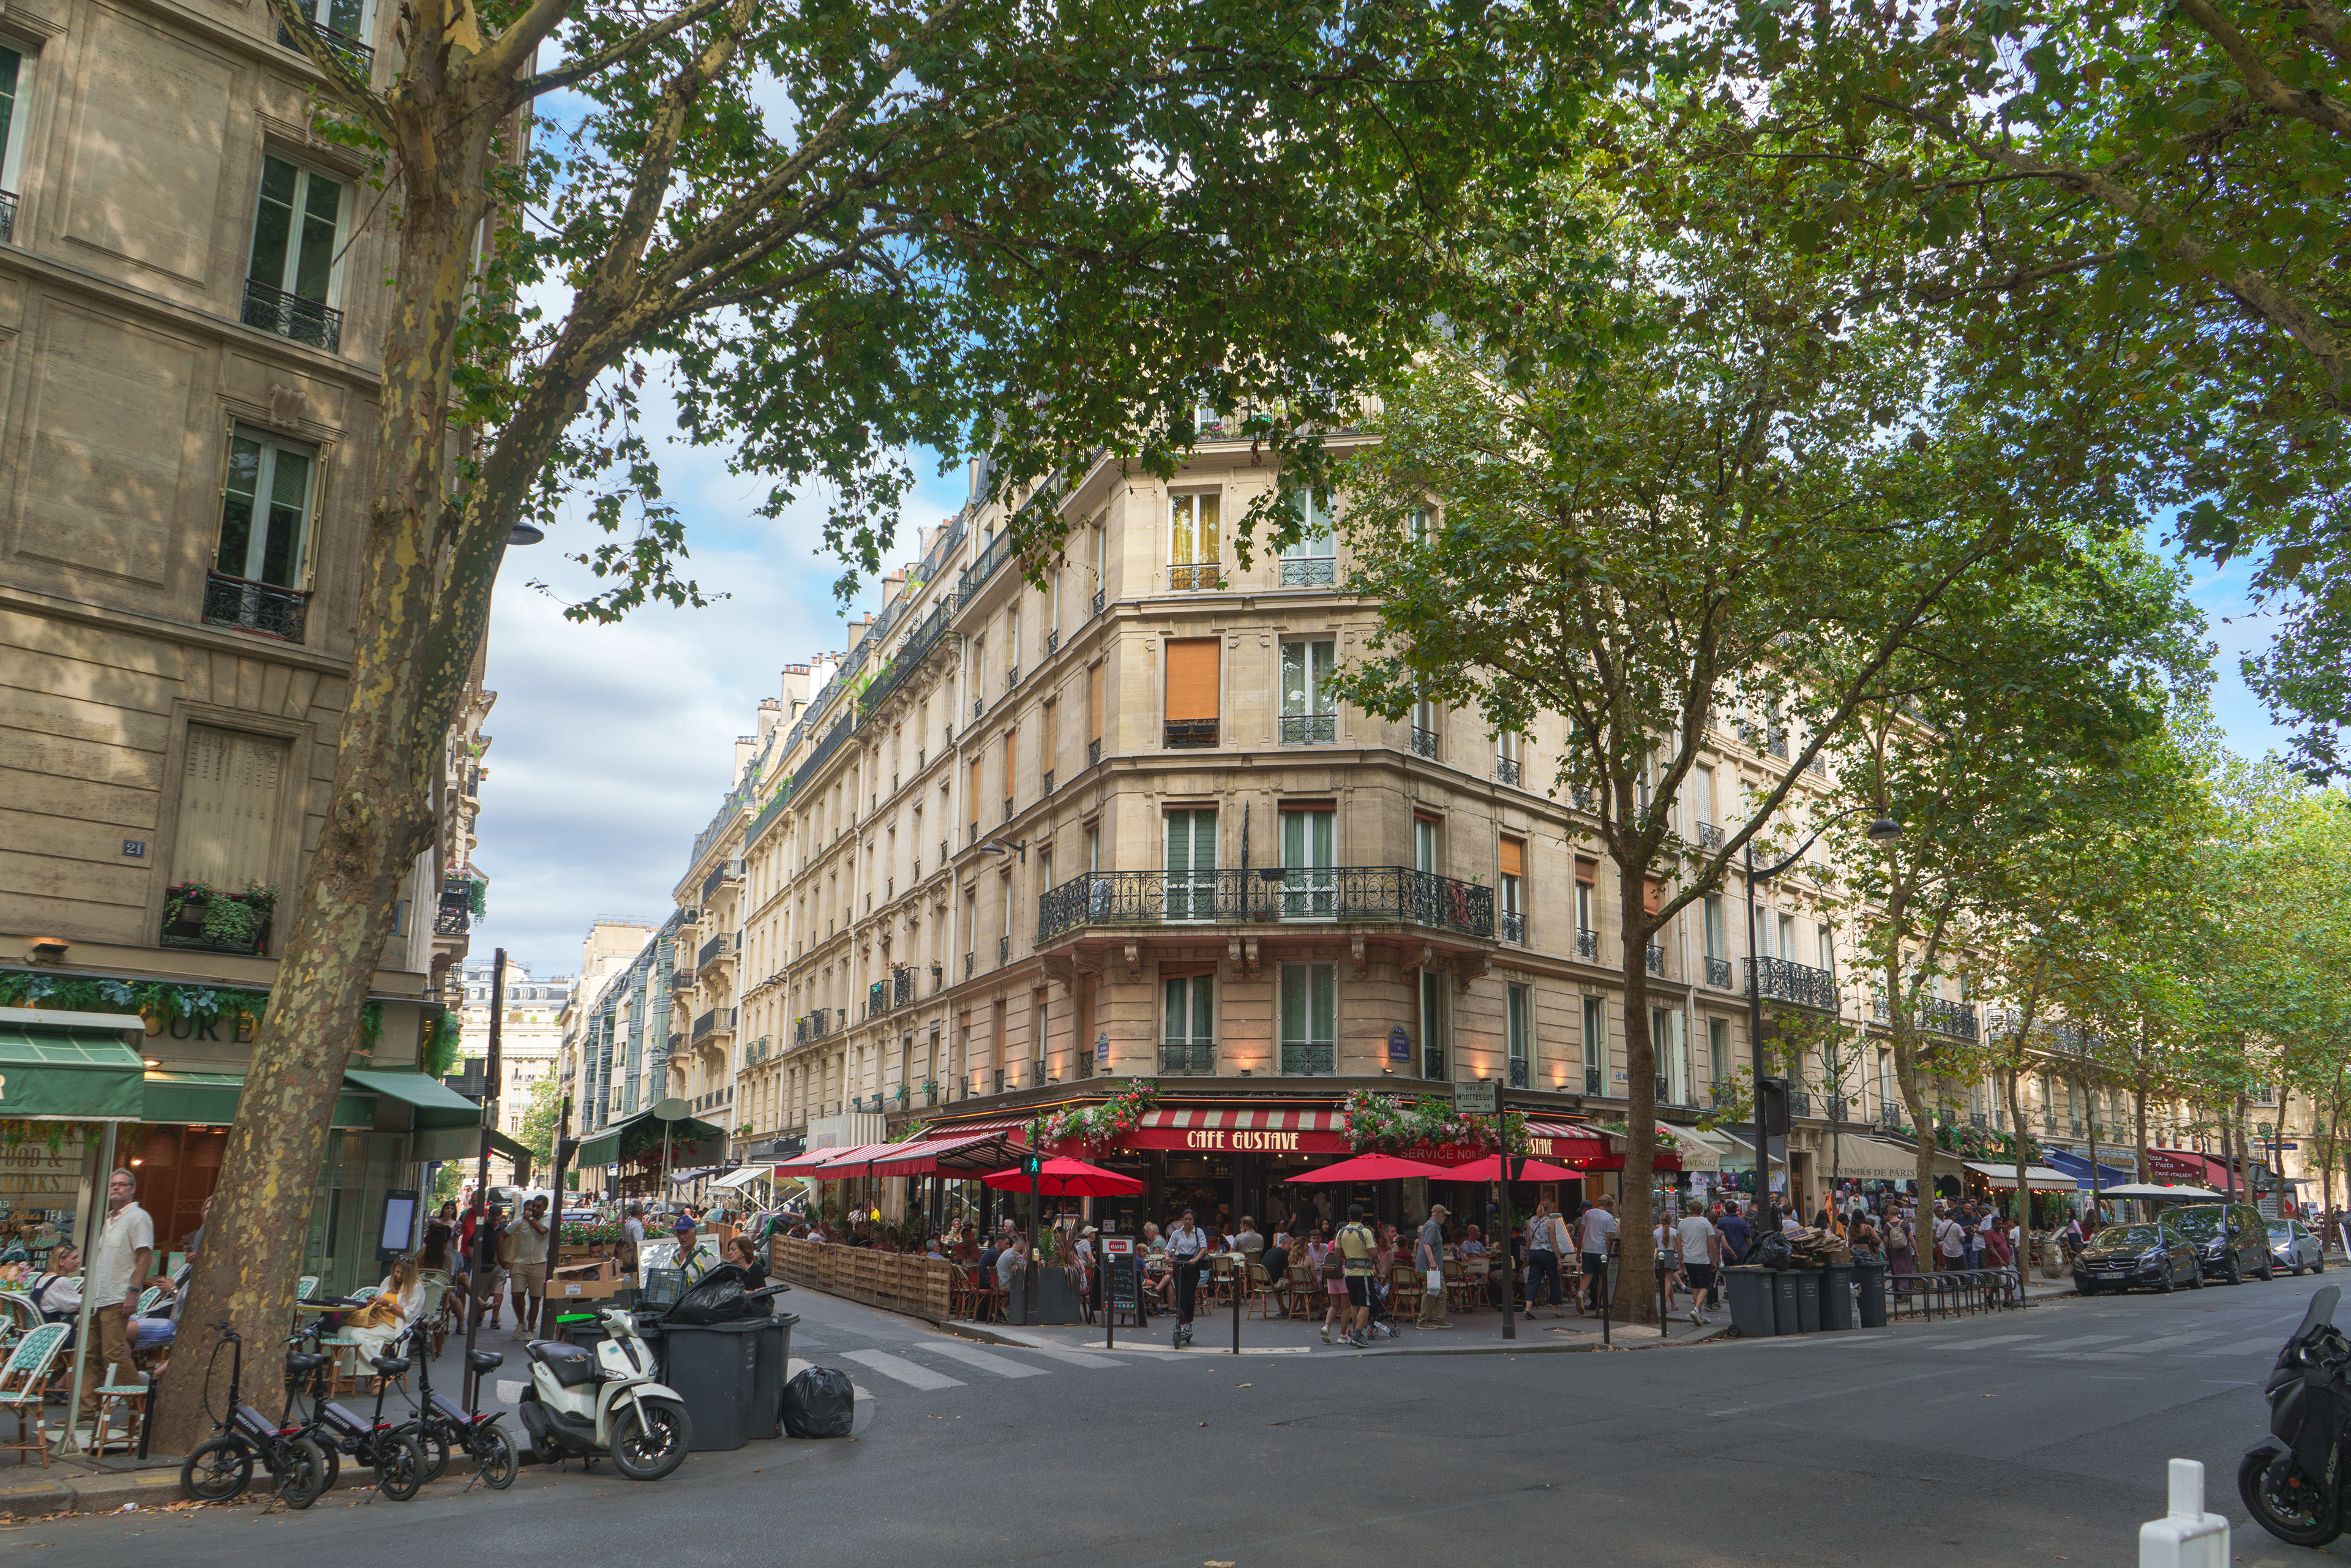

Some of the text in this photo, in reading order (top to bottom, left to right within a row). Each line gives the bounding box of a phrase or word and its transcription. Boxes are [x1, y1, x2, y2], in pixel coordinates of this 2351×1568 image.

[126, 842, 142, 855] 21
[1655, 1108, 1668, 1118] GIFT
[1670, 1109, 1683, 1120] SHOP
[1187, 1130, 1299, 1150] CAFE GUSTAVE
[47, 1149, 63, 1168] &
[1400, 1149, 1454, 1159] SERVICE
[1457, 1149, 1476, 1159] NON
[10, 1210, 42, 1223] Cakes
[7, 1235, 26, 1247] du
[29, 1234, 60, 1248] Jour
